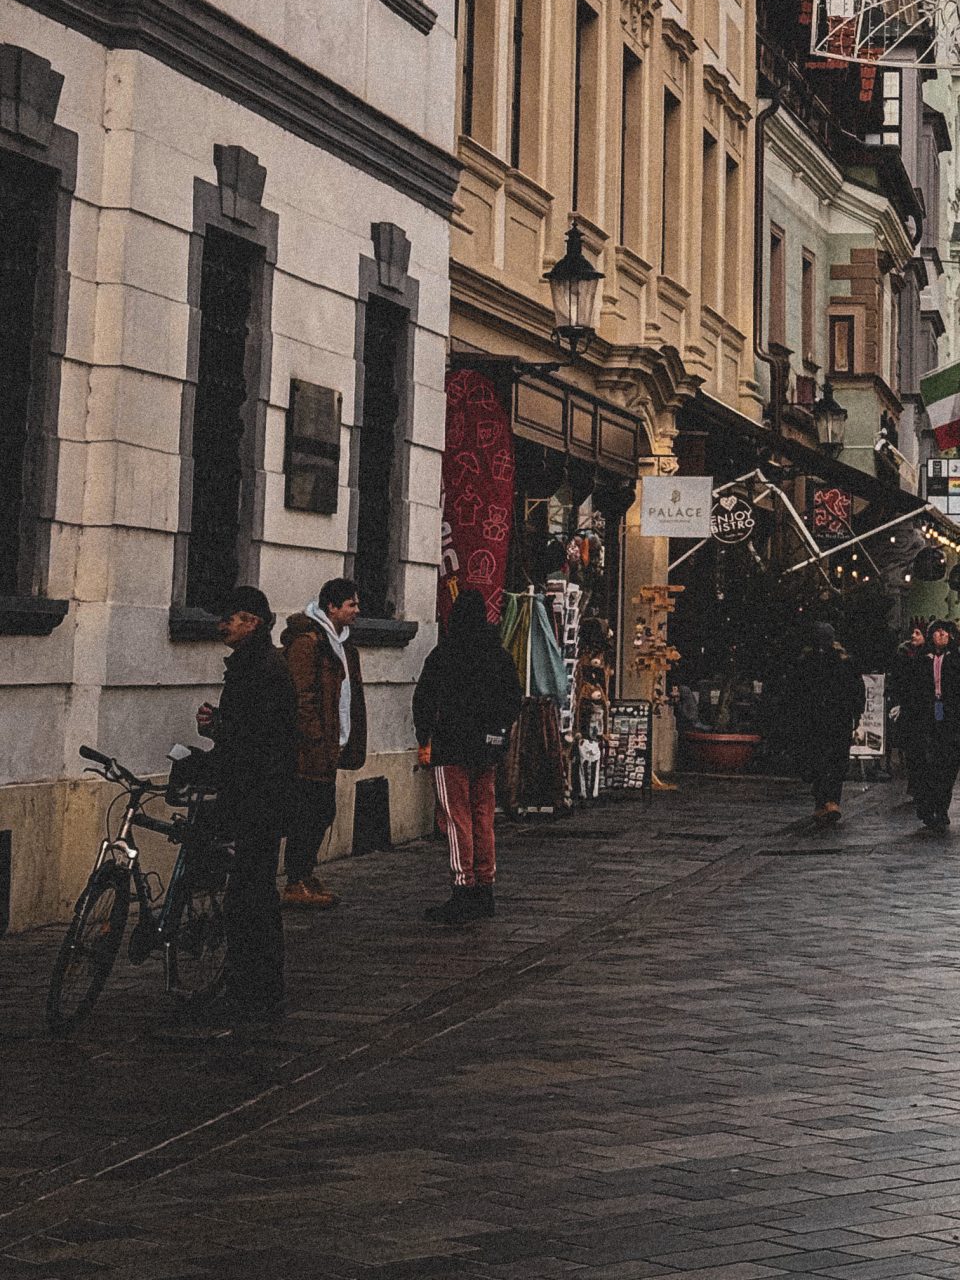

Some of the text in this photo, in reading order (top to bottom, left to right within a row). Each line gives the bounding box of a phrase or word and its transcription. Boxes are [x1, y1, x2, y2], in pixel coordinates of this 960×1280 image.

[648, 507, 703, 518] PALACE
[711, 509, 753, 525] ENJOY
[711, 518, 756, 534] BISTRO
